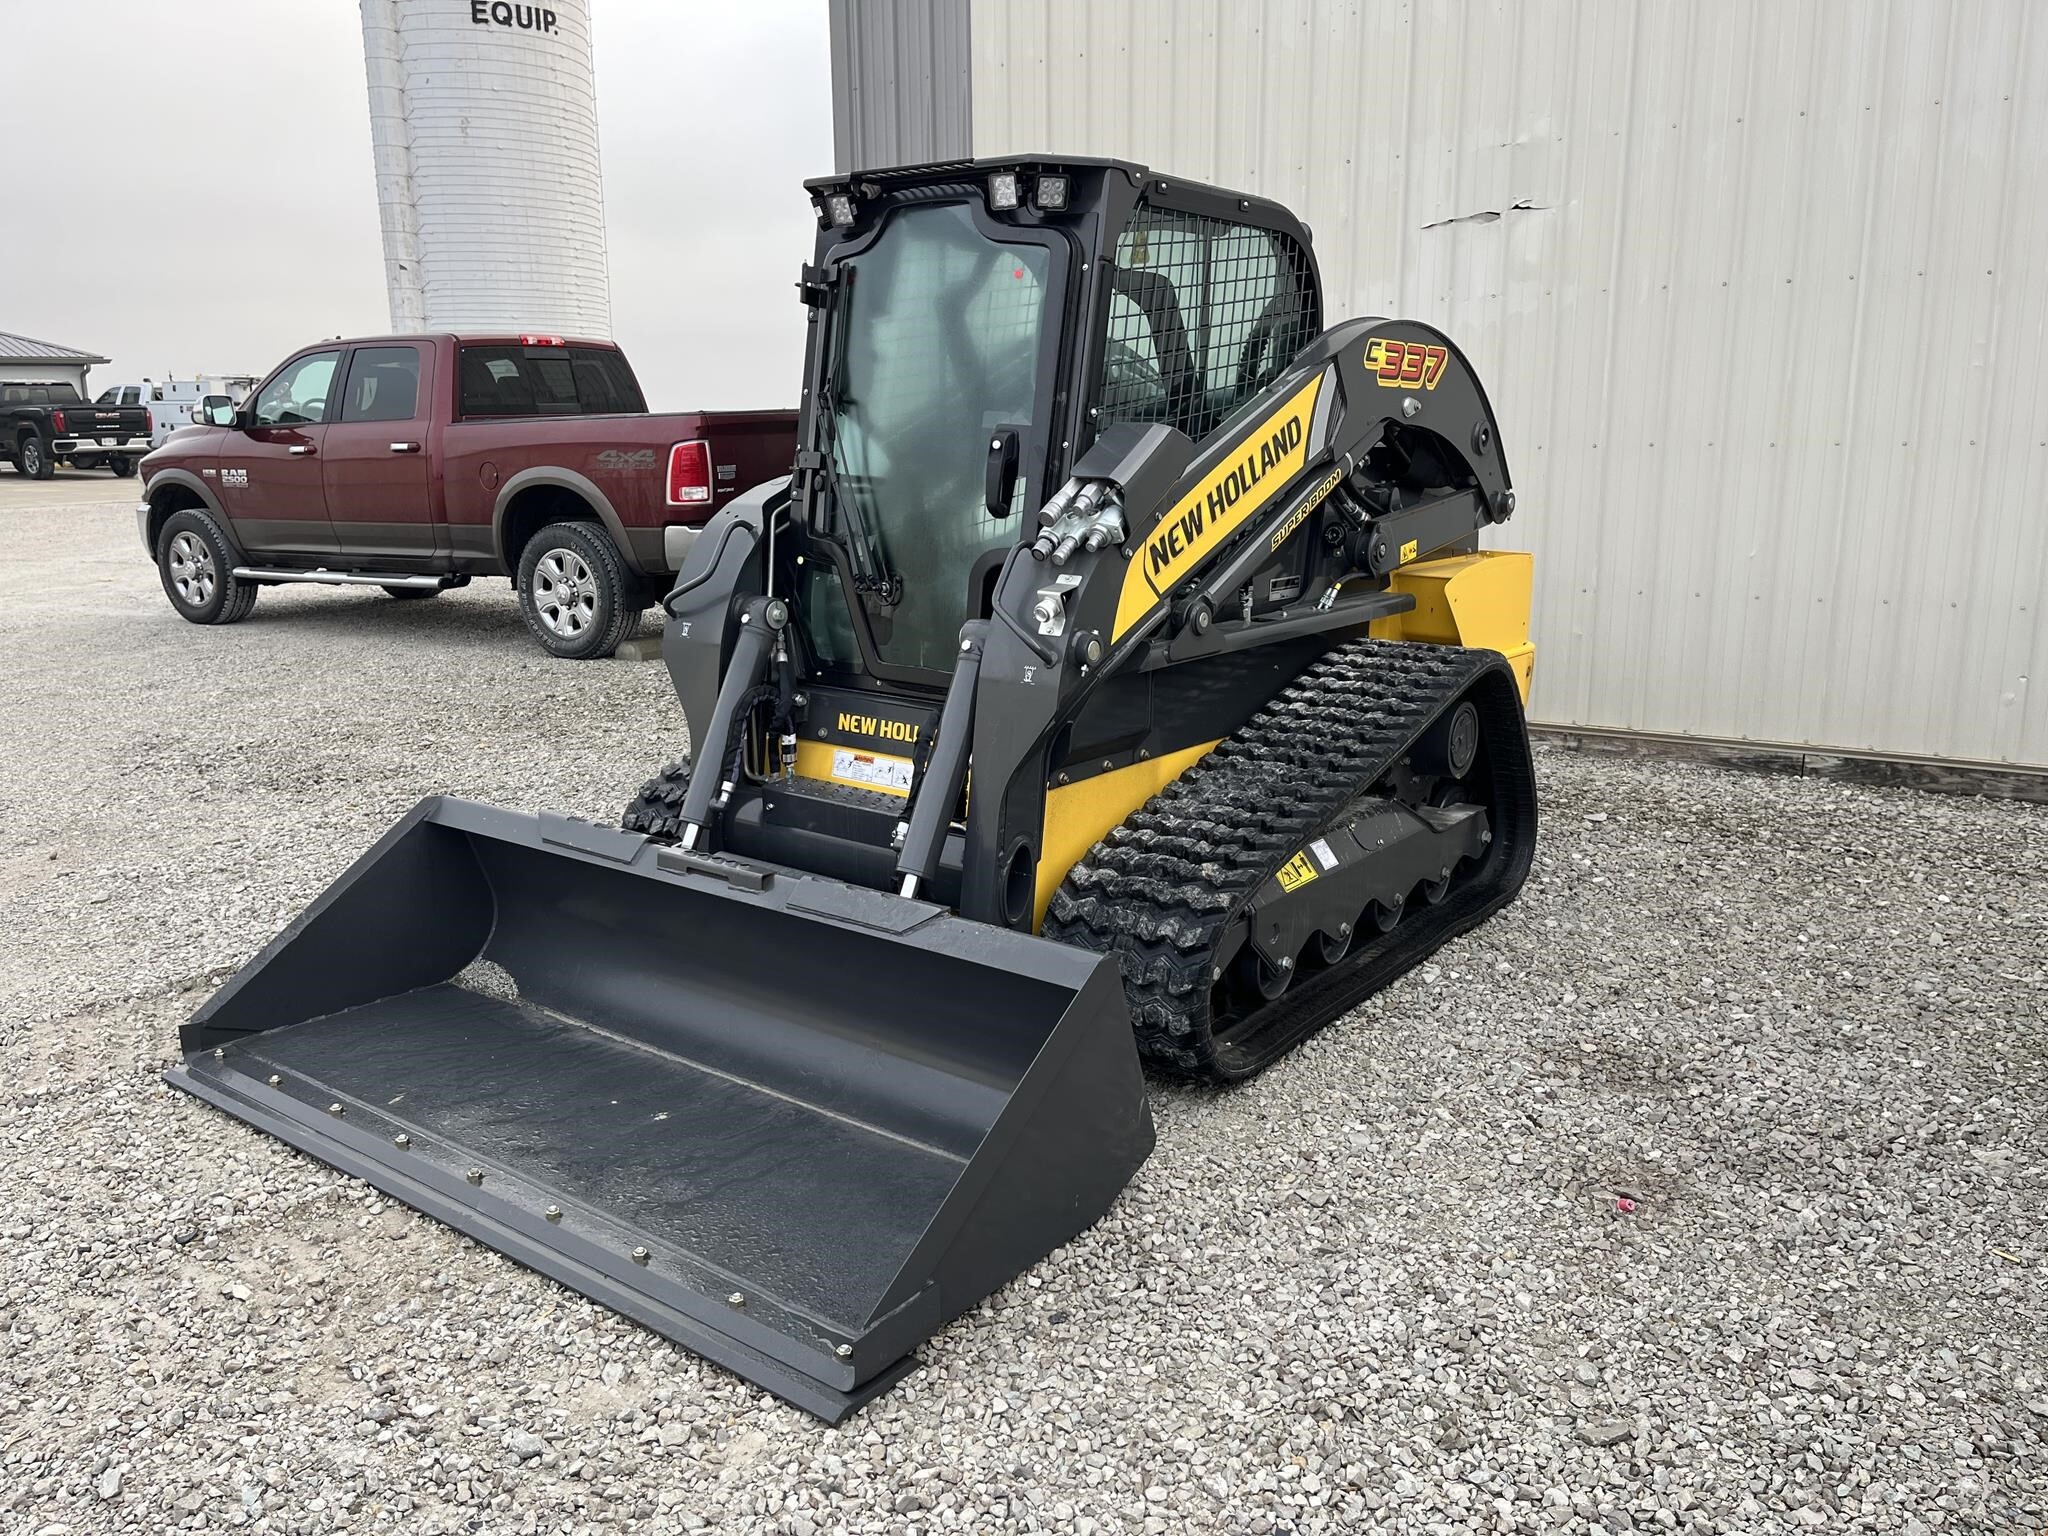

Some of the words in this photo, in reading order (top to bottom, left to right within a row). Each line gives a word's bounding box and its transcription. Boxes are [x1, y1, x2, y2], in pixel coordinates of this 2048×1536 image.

[471, 0, 558, 35] EQUIP.
[1364, 337, 1448, 391] C337
[221, 468, 247, 476] RAM
[222, 475, 248, 484] 2500
[1149, 502, 1204, 576] NEW
[1207, 415, 1303, 523] HOLLAND
[1271, 502, 1310, 552] SUPER
[1309, 467, 1343, 512] BOOM
[838, 712, 877, 736] NEW
